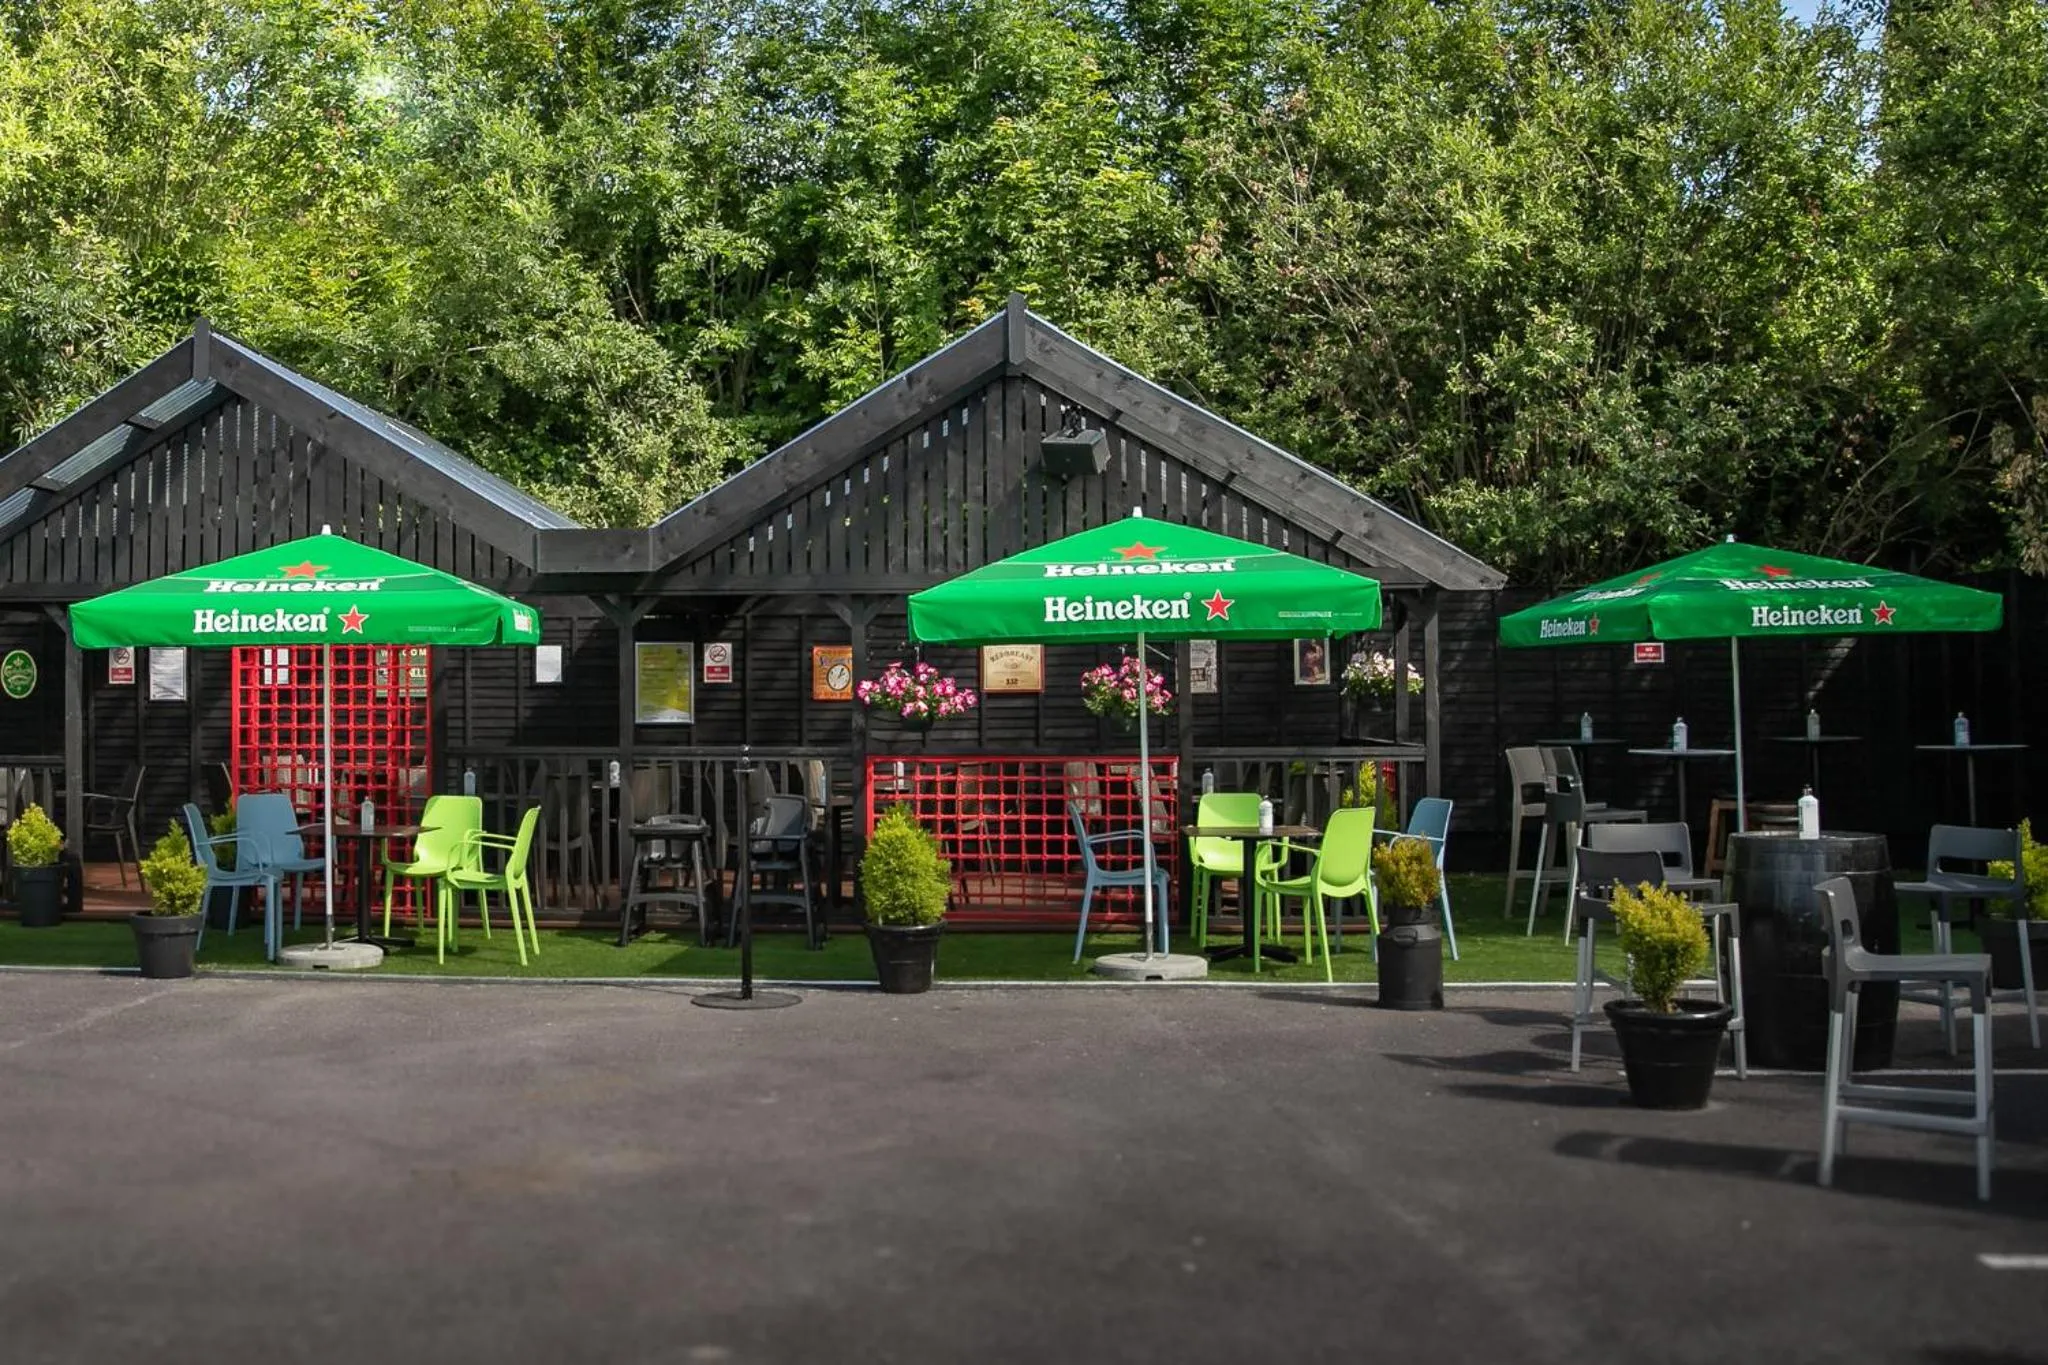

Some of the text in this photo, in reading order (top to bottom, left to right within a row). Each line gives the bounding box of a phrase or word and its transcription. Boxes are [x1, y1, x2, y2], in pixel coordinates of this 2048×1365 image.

[1043, 557, 1236, 577] Heineken
[203, 578, 385, 593] Heineken
[1719, 578, 1875, 590] Heineken
[1044, 594, 1191, 622] Heineken
[1751, 605, 1863, 627] Heineken
[193, 608, 329, 633] Heineken
[1540, 617, 1586, 638] Heineken
